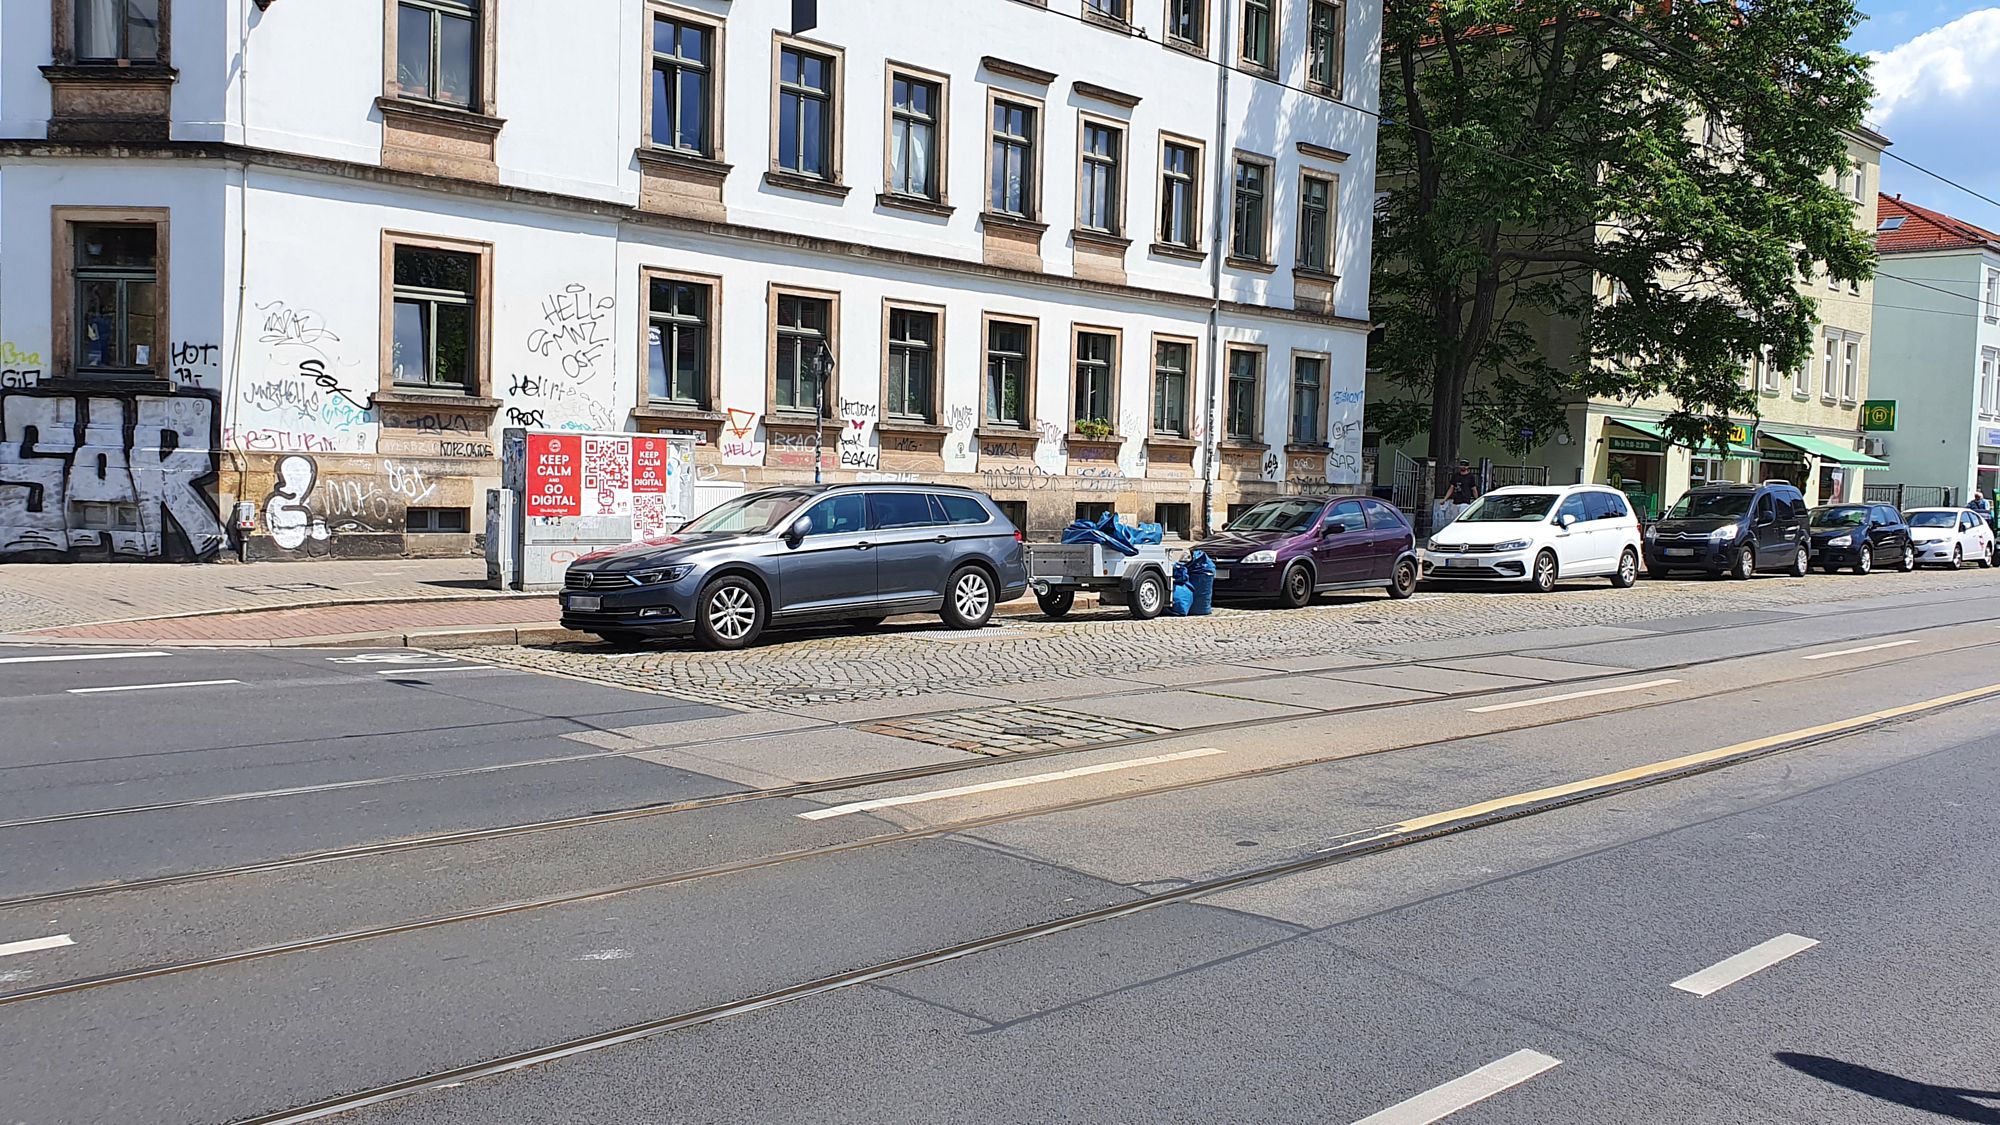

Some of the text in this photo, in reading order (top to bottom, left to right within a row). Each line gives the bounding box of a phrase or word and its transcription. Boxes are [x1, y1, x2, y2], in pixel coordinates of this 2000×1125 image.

[540, 454, 569, 465] KEEP
[639, 451, 659, 459] KEEP
[637, 458, 661, 466] CALM
[536, 465, 572, 476] CALM
[642, 471, 656, 479] GO
[634, 479, 664, 487] DIGITAL
[544, 483, 564, 495] GO
[531, 495, 576, 506] DIGITAL
